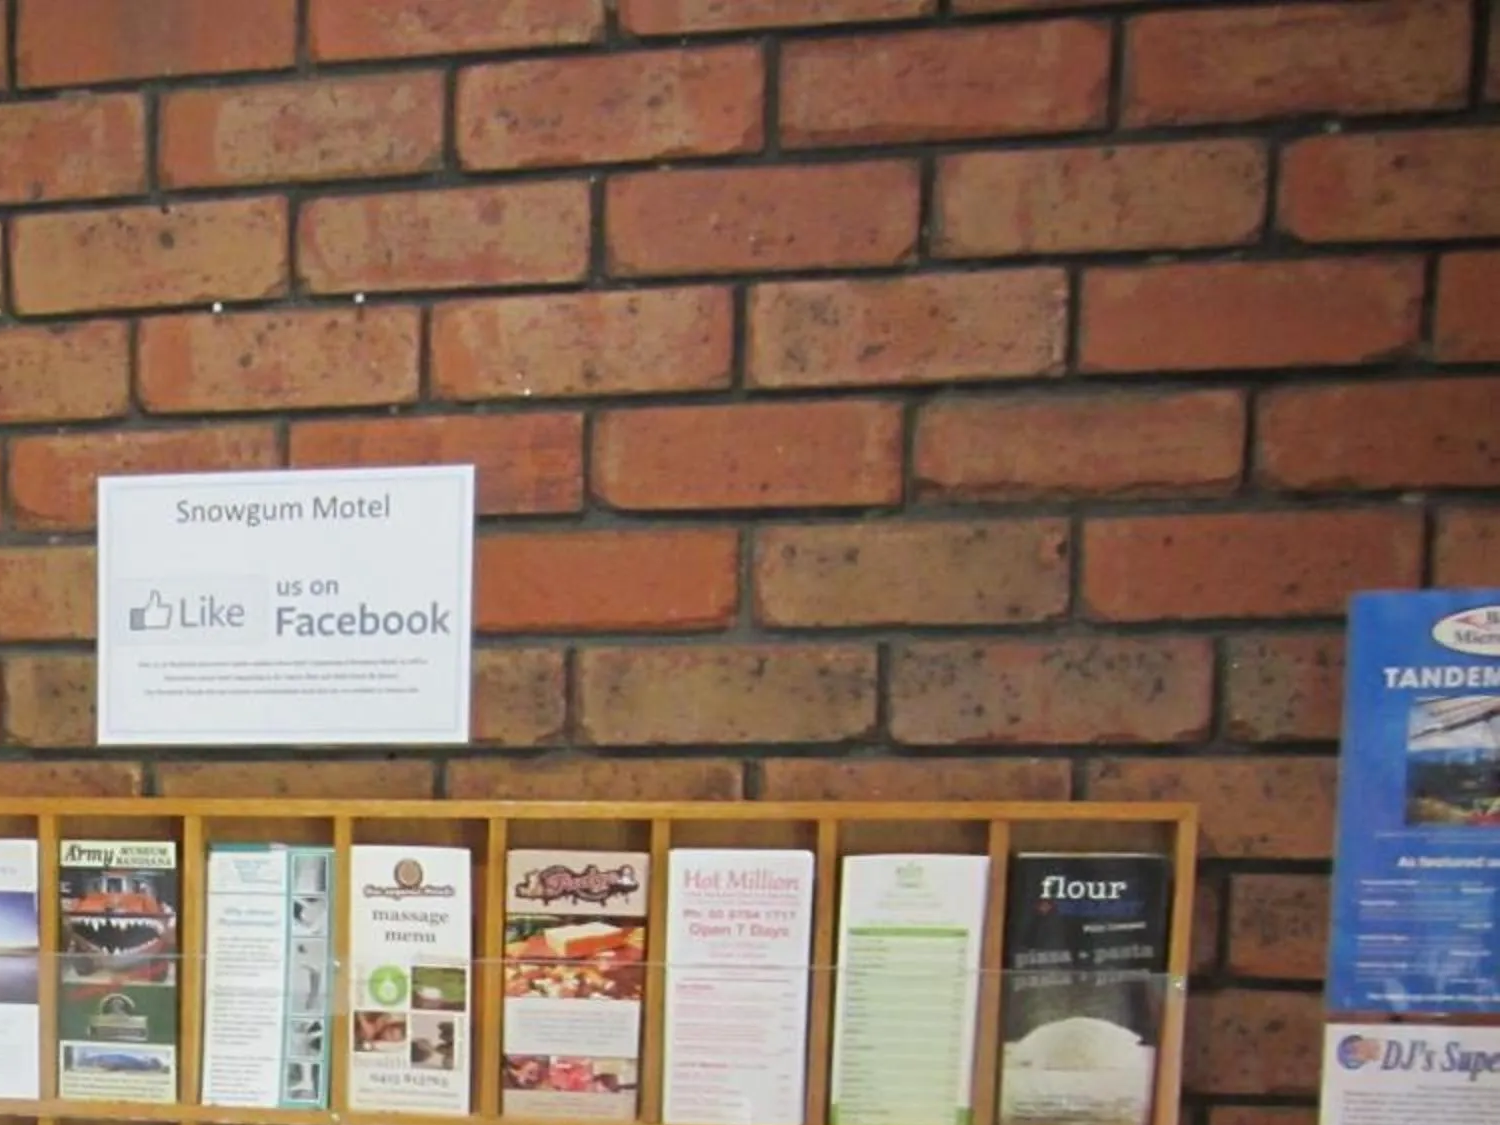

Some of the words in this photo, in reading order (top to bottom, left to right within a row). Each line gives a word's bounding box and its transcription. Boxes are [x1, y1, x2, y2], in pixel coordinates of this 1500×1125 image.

[176, 498, 302, 526] Snowgum
[312, 494, 391, 520] Motel
[276, 580, 302, 597] us
[310, 578, 339, 596] on
[180, 595, 246, 627] Like
[275, 601, 451, 636] Facebook
[65, 844, 115, 868] Army
[684, 868, 719, 889] Hot
[726, 868, 800, 891] Million
[1040, 875, 1128, 899] flour
[372, 910, 450, 926] massage
[689, 922, 732, 938] Open
[749, 923, 790, 938] Days
[385, 931, 437, 943] menu
[1380, 1039, 1438, 1072] DJ's
